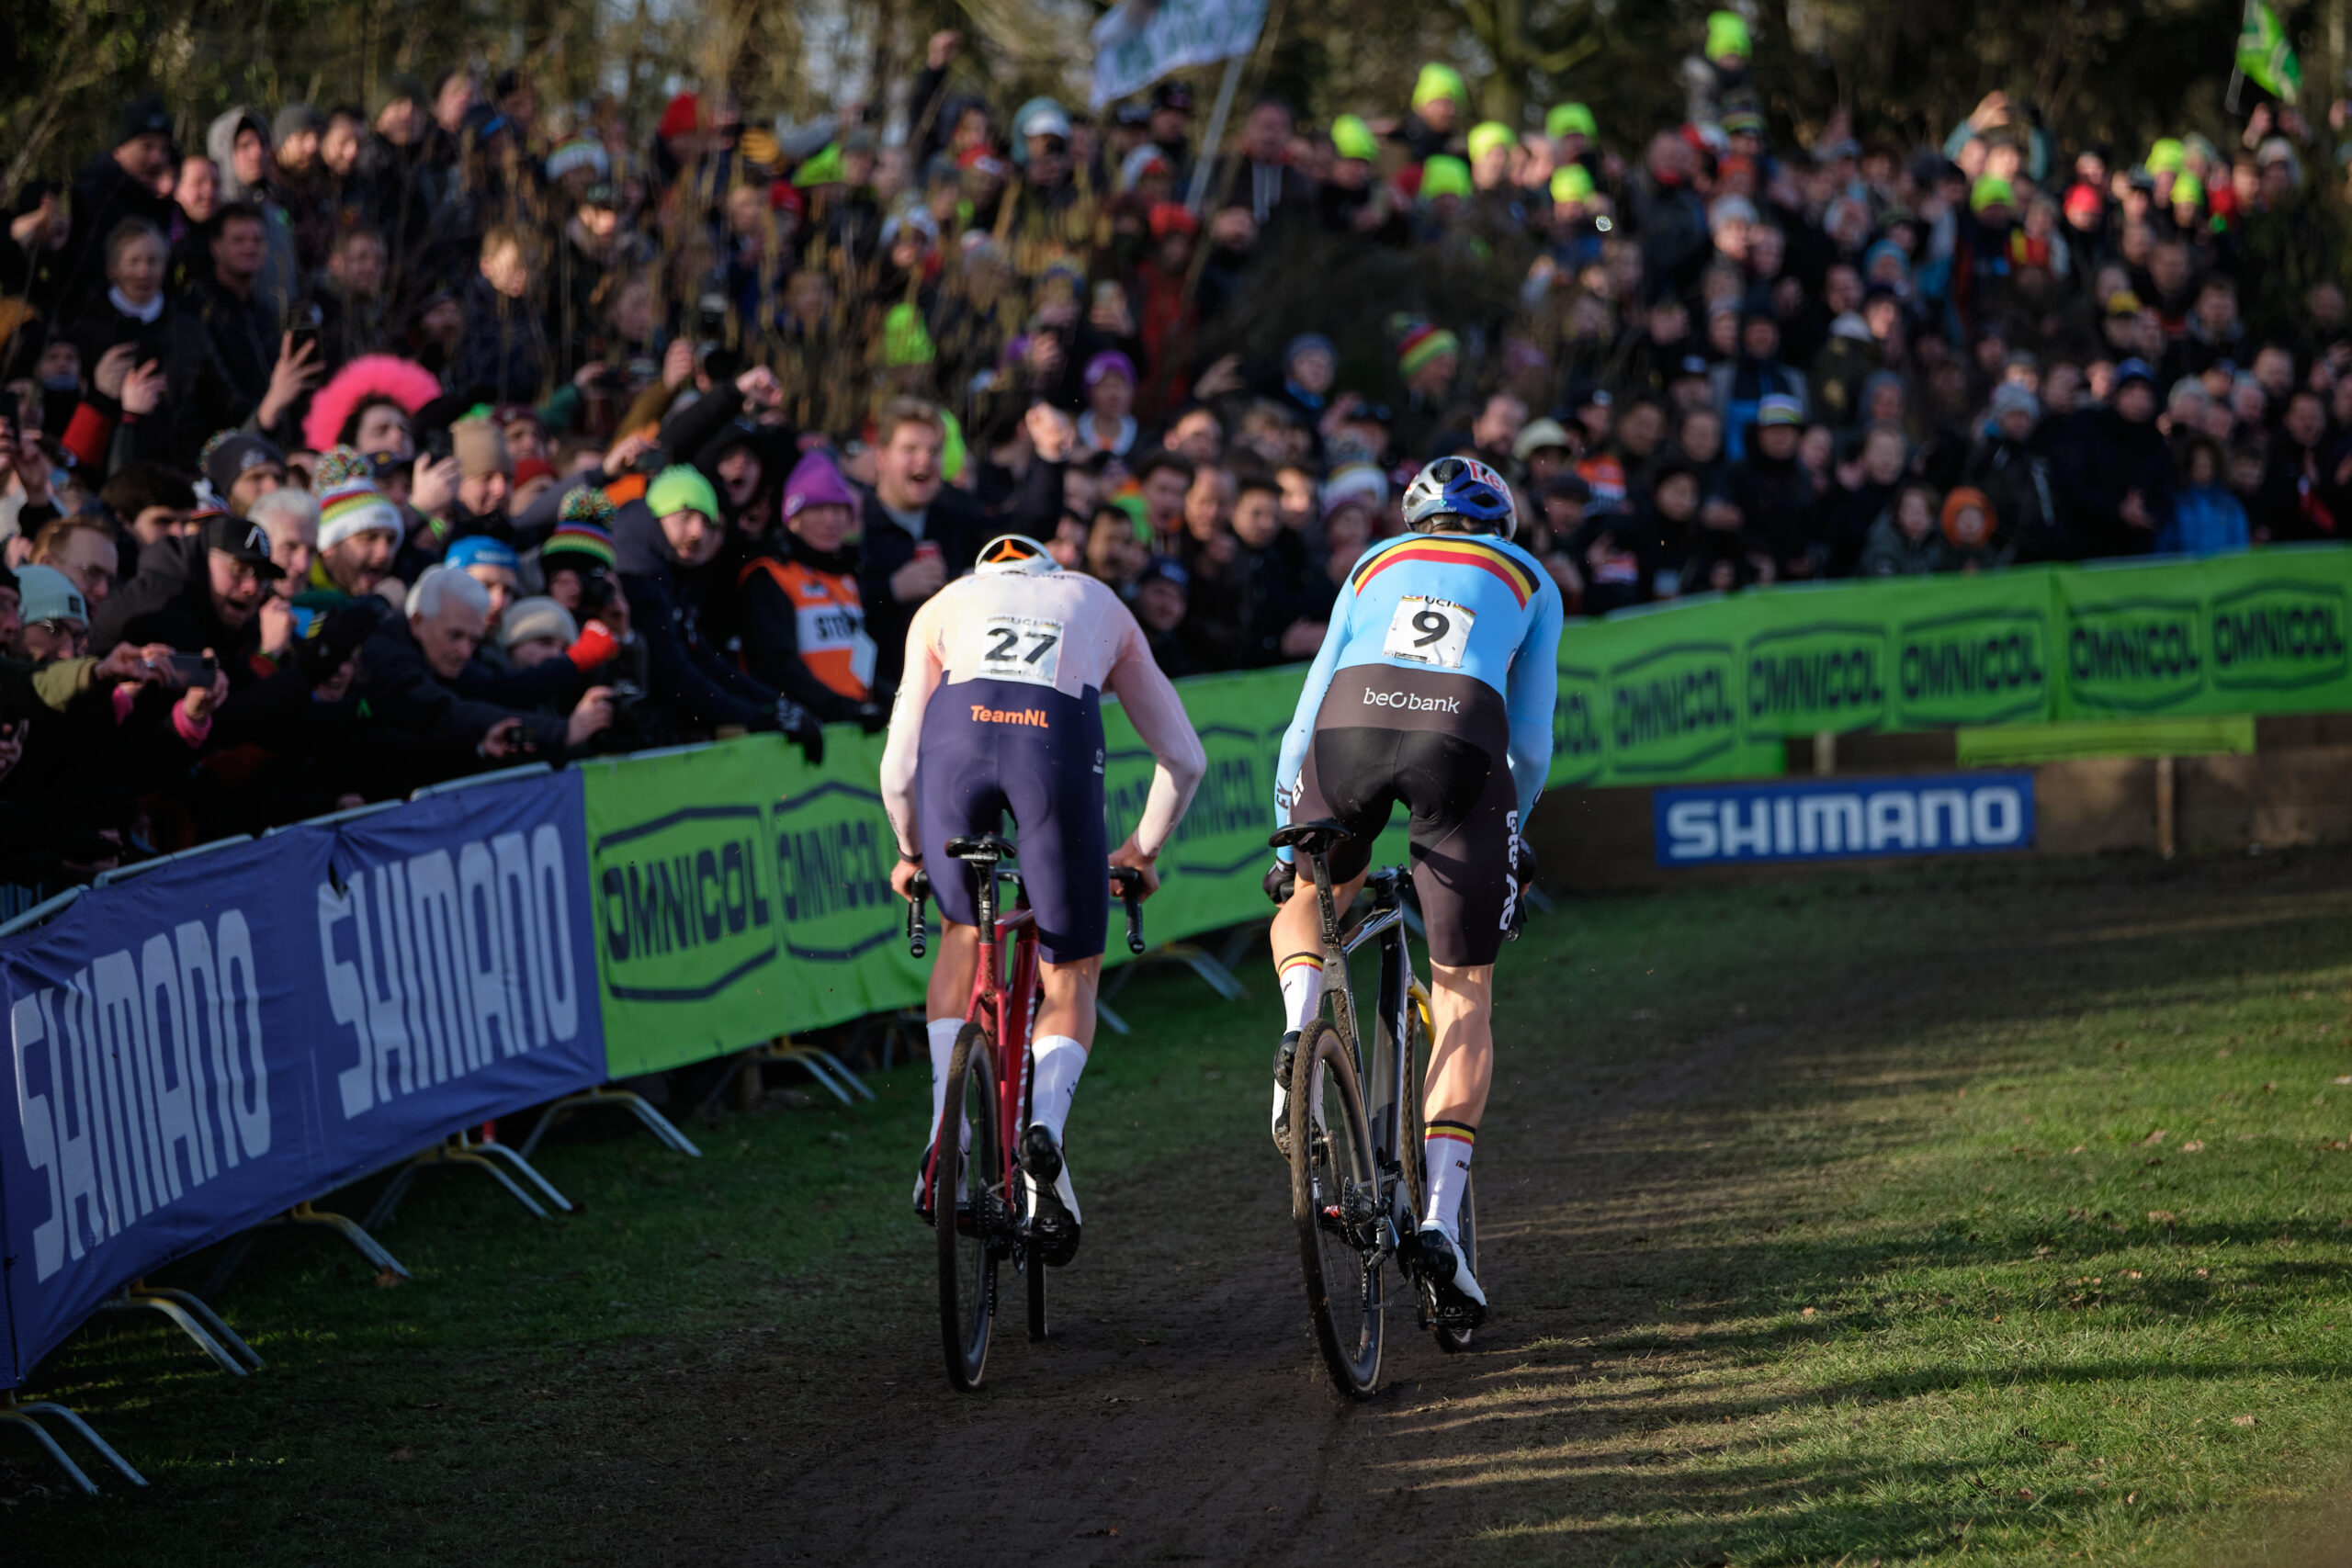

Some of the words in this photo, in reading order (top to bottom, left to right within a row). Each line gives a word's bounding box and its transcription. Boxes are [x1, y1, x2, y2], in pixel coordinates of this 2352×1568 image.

[815, 615, 856, 641] STE
[984, 627, 1057, 665] 27
[1412, 611, 1450, 648] 9
[2213, 607, 2345, 665] OMNICOL
[1748, 647, 1884, 718] OMNICOL
[1900, 635, 2042, 698] OMNICOL
[970, 705, 1049, 728] TeamNL
[1612, 667, 1735, 749] OMNICOL
[1667, 785, 2022, 860] SHIMANO
[602, 837, 770, 962] OMNICOL
[779, 819, 892, 921] OMNICOL
[317, 823, 579, 1120] SHIMANO
[11, 908, 272, 1283] SHIMANO
